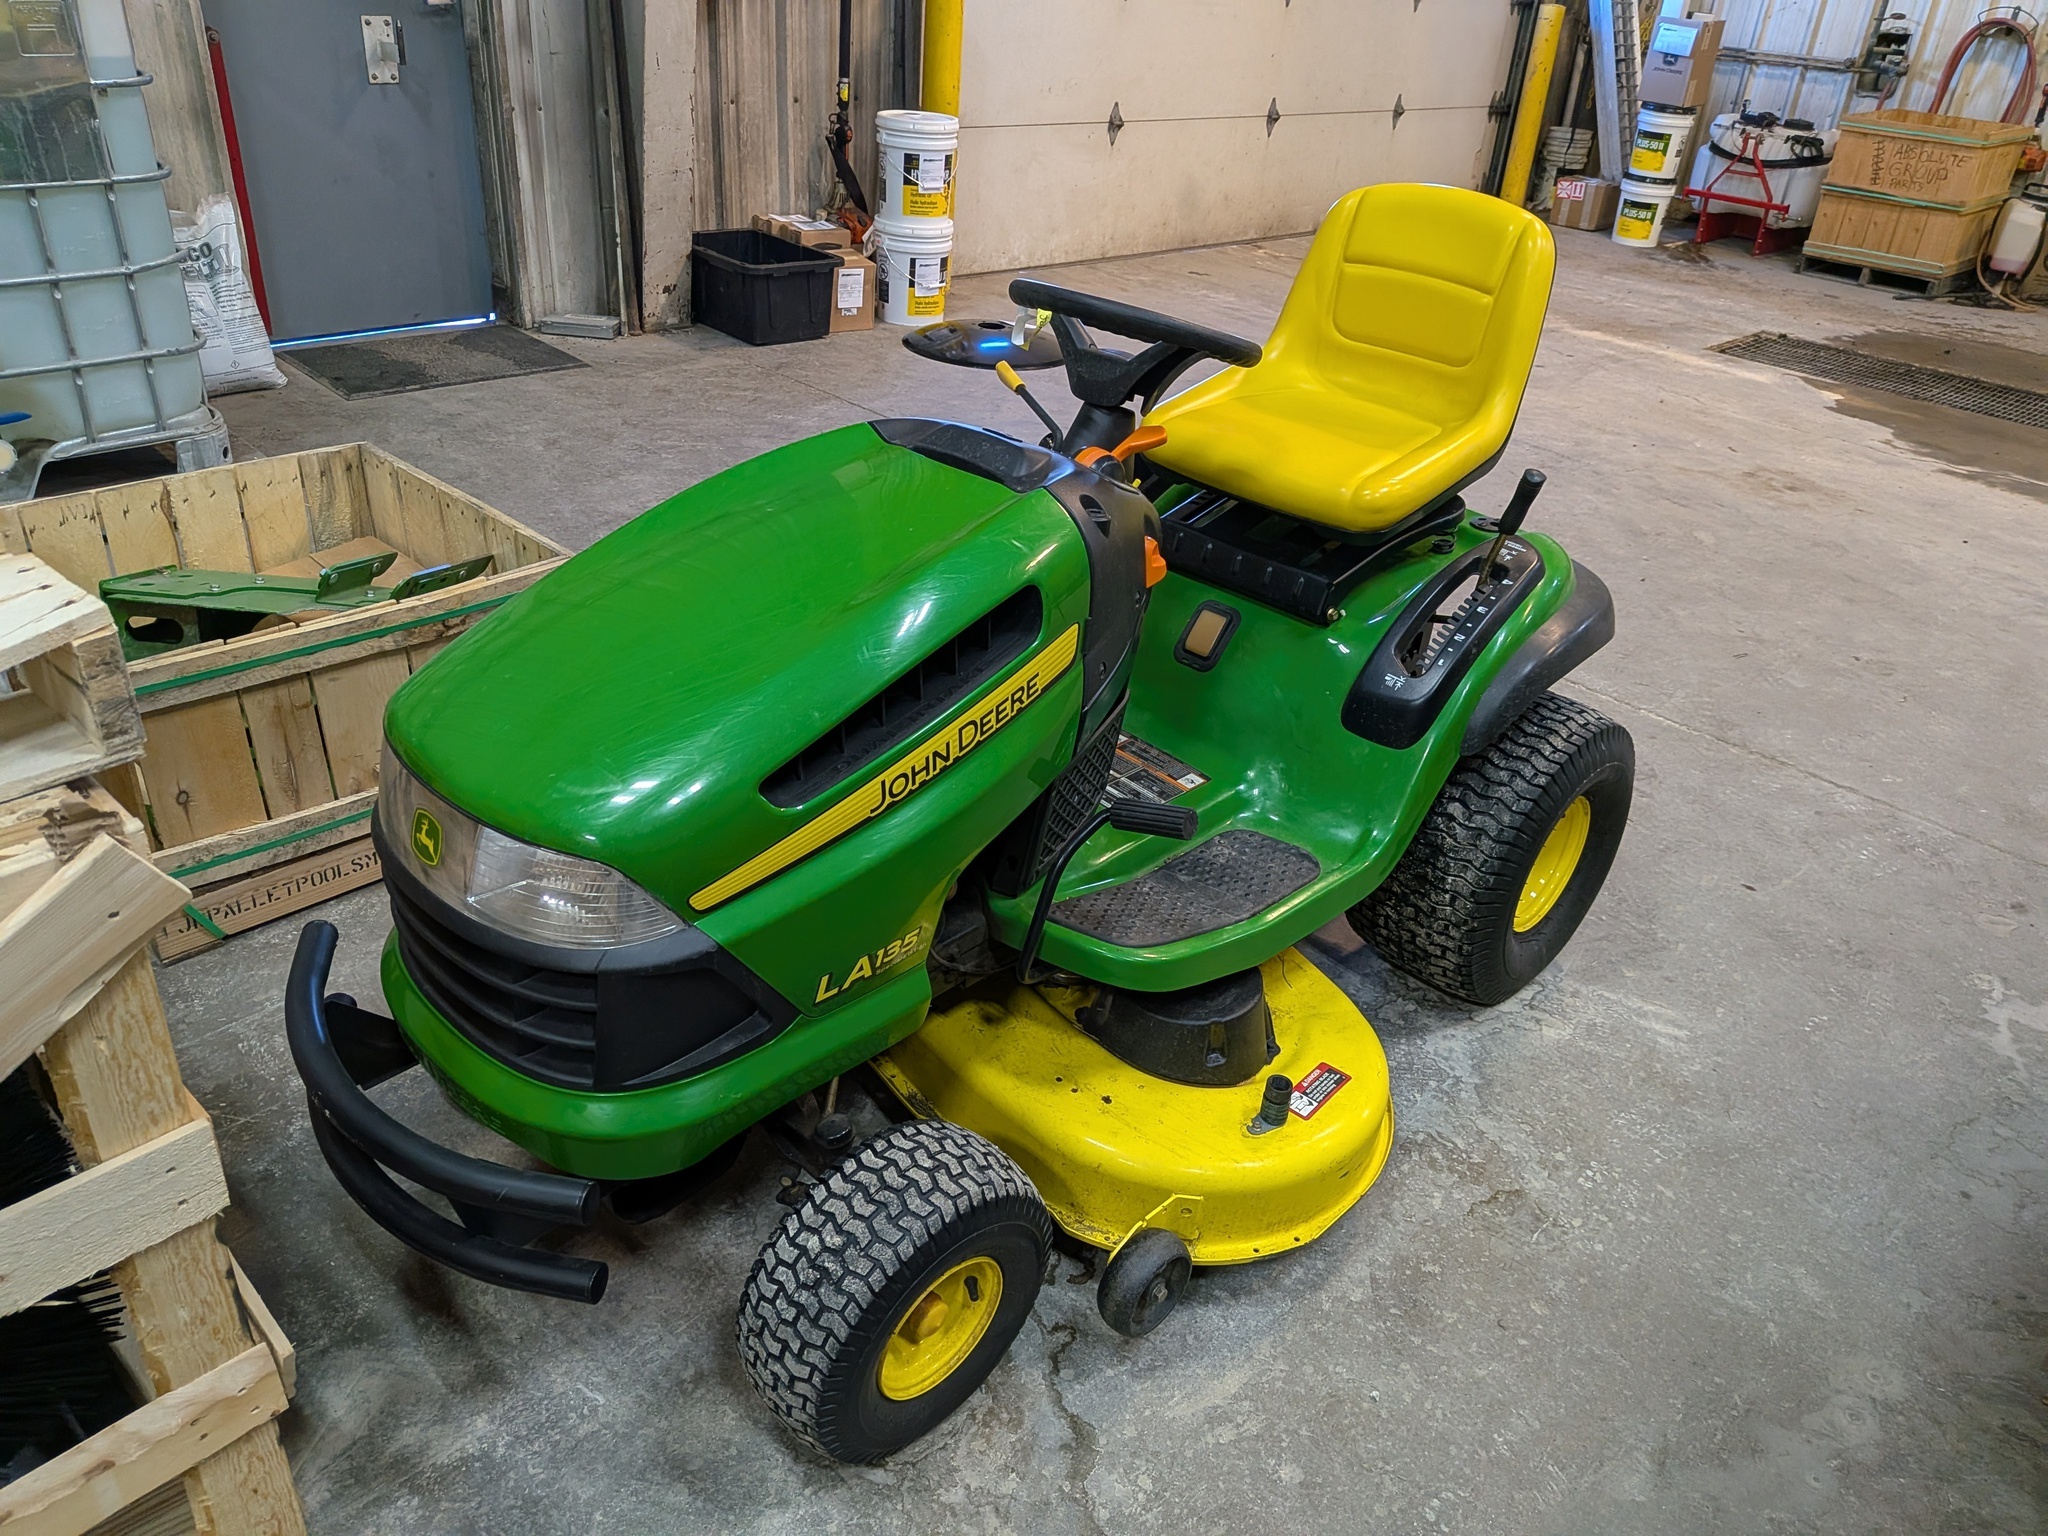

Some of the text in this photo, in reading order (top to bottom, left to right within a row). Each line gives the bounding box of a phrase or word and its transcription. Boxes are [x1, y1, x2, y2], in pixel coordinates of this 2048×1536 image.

[1635, 138, 1658, 149] PLUS-50
[1893, 144, 1973, 168] ABSOLUTE
[1888, 161, 1949, 185] GROUP
[1622, 208, 1647, 219] PLUS-50
[869, 672, 1040, 815] JOHN DEERE
[1304, 1069, 1321, 1084] DANGER
